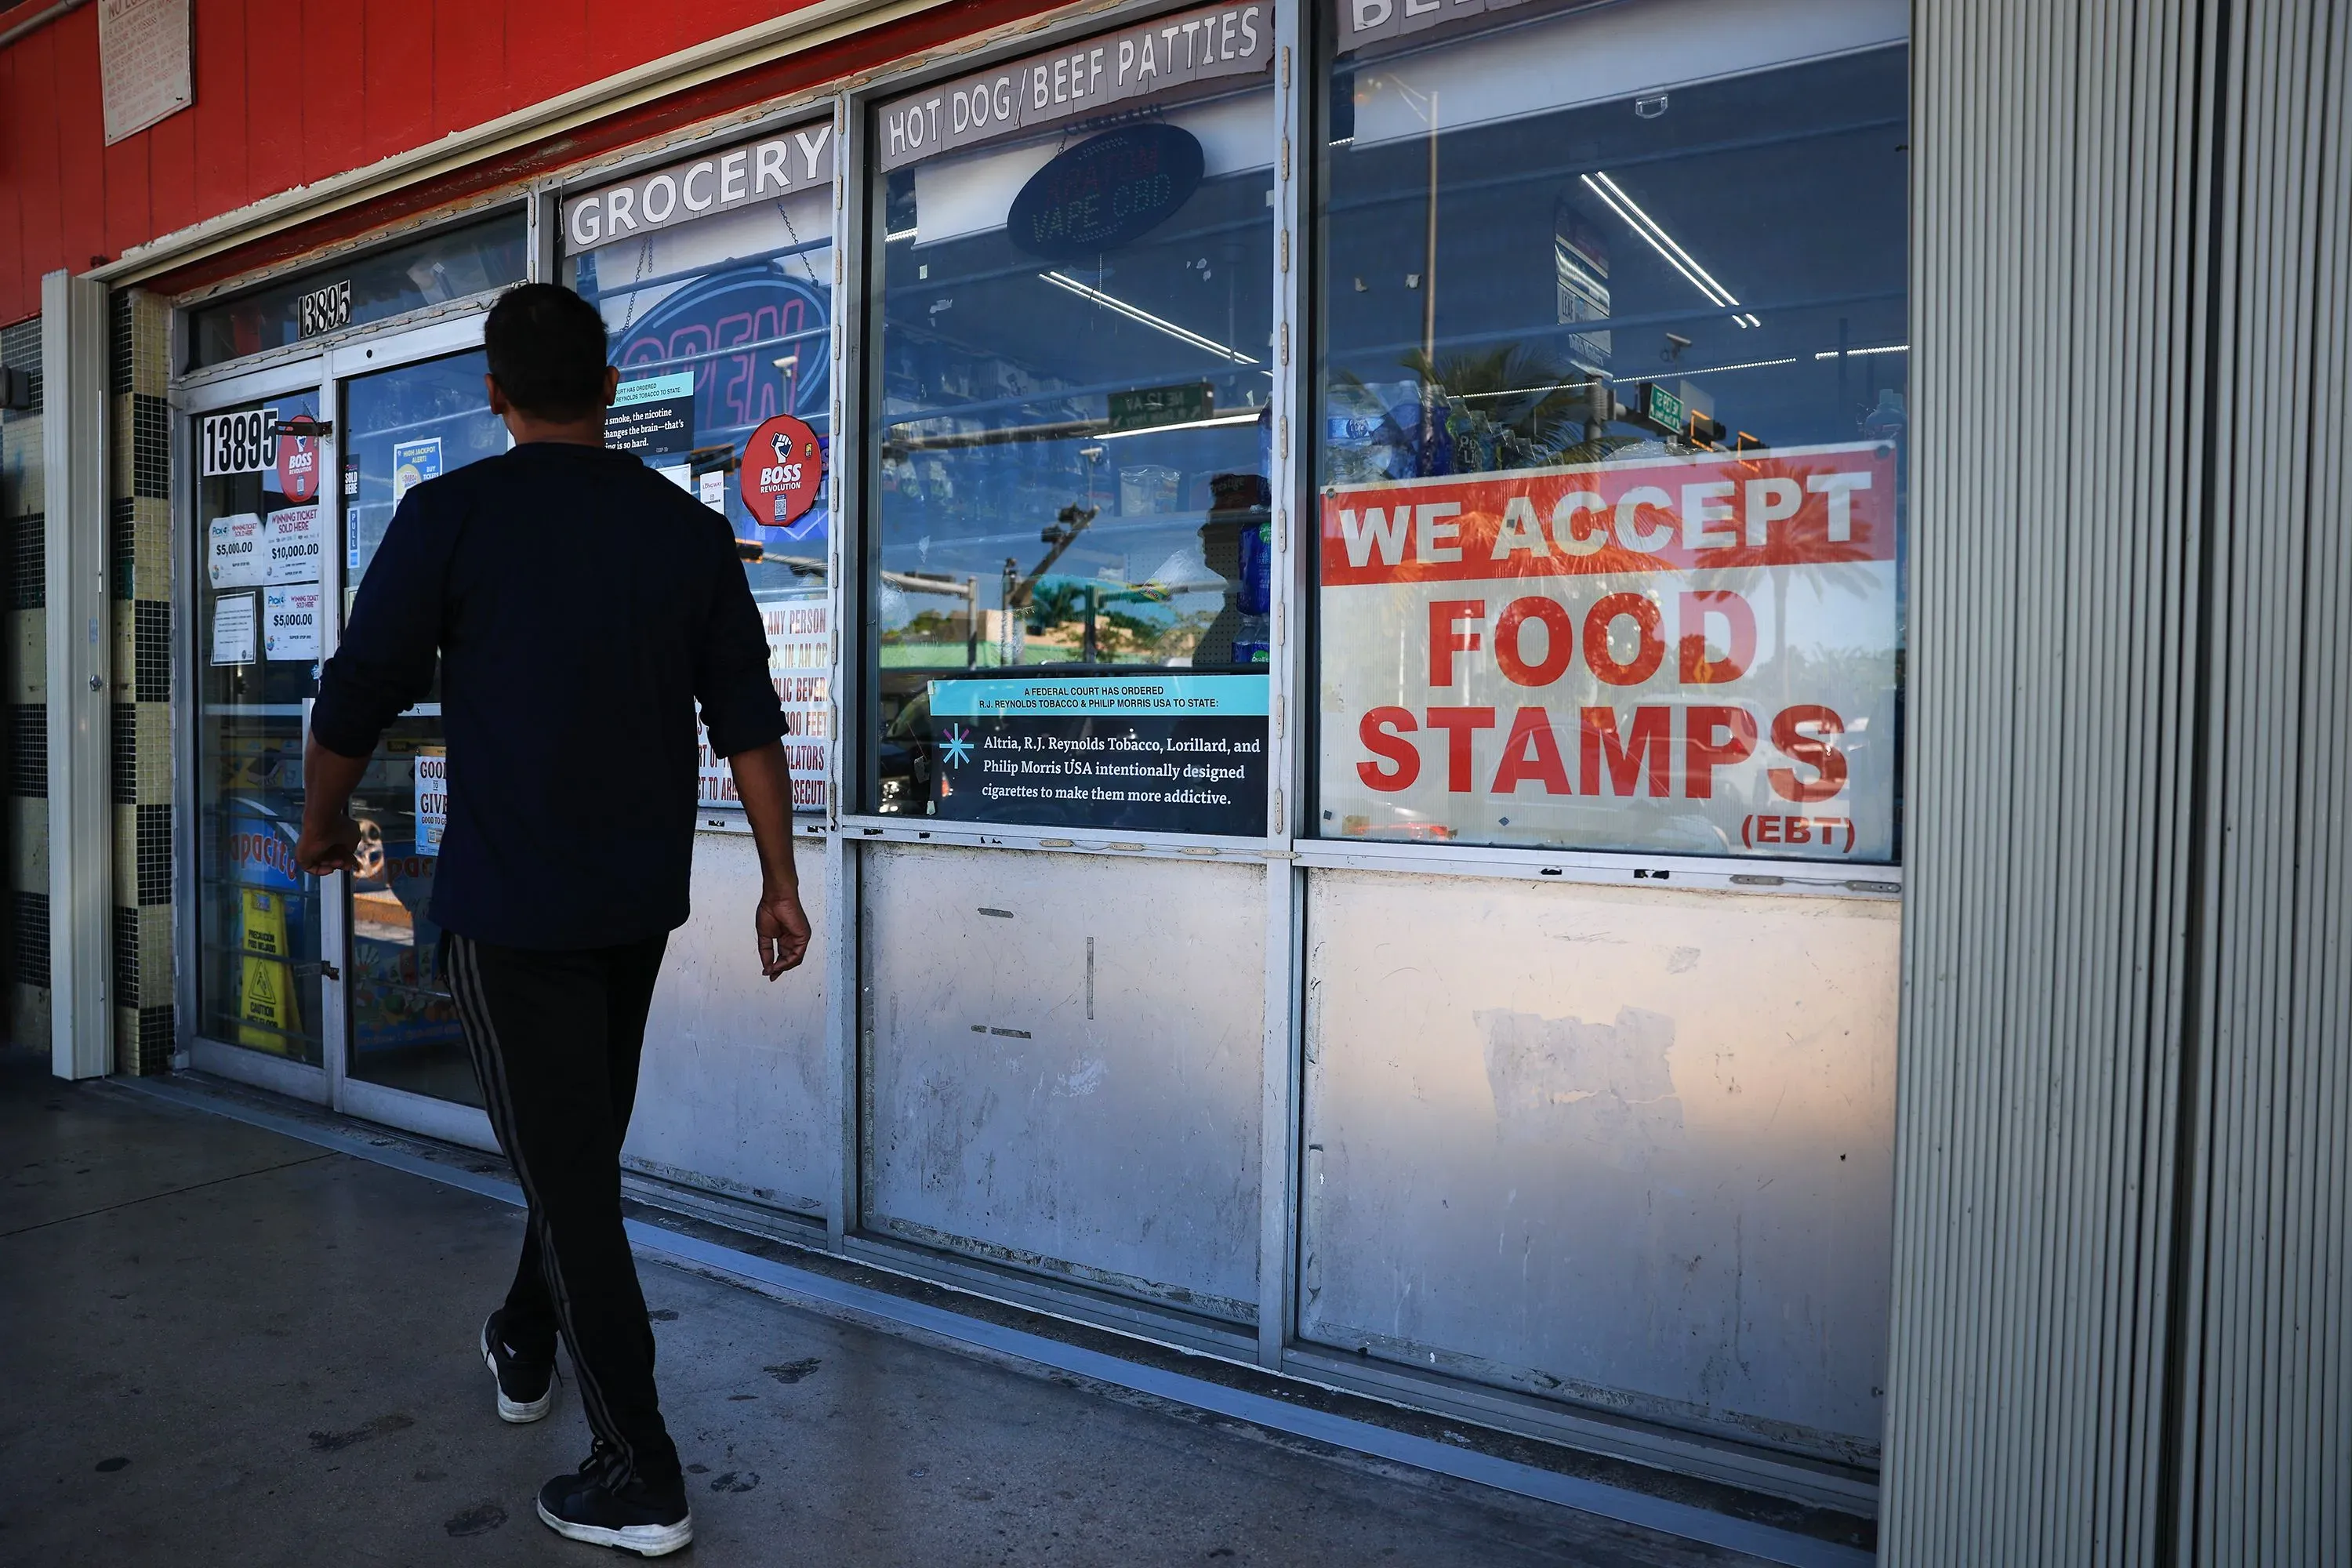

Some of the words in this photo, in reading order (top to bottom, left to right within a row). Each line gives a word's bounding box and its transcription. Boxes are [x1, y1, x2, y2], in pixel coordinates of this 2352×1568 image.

[889, 98, 941, 156] HOT
[953, 47, 1104, 135] DOG/BEEF
[1118, 6, 1259, 87] PATTIES
[572, 125, 833, 245] GROCERY
[1033, 193, 1100, 244] VAPE
[1113, 173, 1172, 218] CBD
[299, 281, 350, 339] 13895
[616, 393, 638, 402] REYNOLDS
[639, 390, 660, 398] TOBACCO
[609, 413, 632, 424] smoke,
[633, 412, 643, 421] the
[644, 408, 672, 419] nicotine
[629, 426, 640, 435] the
[207, 412, 278, 472] 13895
[617, 441, 622, 449] is
[631, 437, 649, 448] hard.
[415, 446, 436, 456] JACKPOT
[289, 452, 312, 469] BOSS
[289, 466, 312, 476] REVOLUTION
[345, 472, 358, 484] SOLD
[760, 463, 802, 485] BOSS
[345, 484, 358, 495] HERE
[760, 482, 801, 494] REVOLUTION
[272, 511, 296, 524] WINNING
[296, 510, 318, 521] TICKET
[1338, 502, 1462, 568] WE
[1490, 471, 1872, 561] ACCEPT
[278, 523, 293, 534] SOLD
[293, 521, 309, 532] HERE
[216, 541, 252, 557] $5,000.00
[271, 543, 318, 560] $10,000.00
[274, 614, 313, 628] $5,000.00
[768, 610, 786, 635] ANY
[789, 608, 826, 634] PERSON
[1428, 590, 1757, 688] FOOD
[785, 644, 794, 669] IN
[798, 643, 811, 668] AN
[815, 643, 828, 668] OP
[1031, 688, 1069, 696] FEDERAL
[1071, 687, 1099, 695] COURT
[1102, 687, 1119, 695] HAS
[1121, 686, 1163, 695] ORDERED
[995, 699, 1036, 708] REYNOLDS
[1038, 699, 1078, 708] TOBACCO
[1089, 699, 1115, 708] PHILIP
[1117, 699, 1151, 707] MORRIS
[1153, 699, 1171, 707] USA
[1174, 699, 1185, 707] TO
[1188, 699, 1219, 707] STATE:
[806, 710, 828, 736] FEET
[984, 736, 1022, 751] Altria,
[1024, 737, 1045, 752] R.J.
[1048, 738, 1105, 753] Reynolds
[1108, 737, 1164, 754] Tobacco,
[1167, 738, 1231, 755] Lorillard,
[1234, 739, 1261, 753] and
[1356, 704, 1848, 802] STAMPS
[983, 760, 1018, 776] Philip
[1021, 760, 1061, 774] Morris
[1064, 761, 1092, 775] USA
[1095, 762, 1181, 780] intentionally
[1183, 764, 1245, 782] designed
[708, 776, 718, 800] TO
[982, 783, 1038, 800] cigarettes
[1040, 786, 1052, 798] to
[1055, 786, 1088, 800] make
[1091, 786, 1125, 801] them
[1127, 790, 1162, 803] more
[1164, 789, 1232, 804] addictive.
[1741, 813, 1856, 854] (EBT)
[250, 1002, 274, 1018] CAUTION
